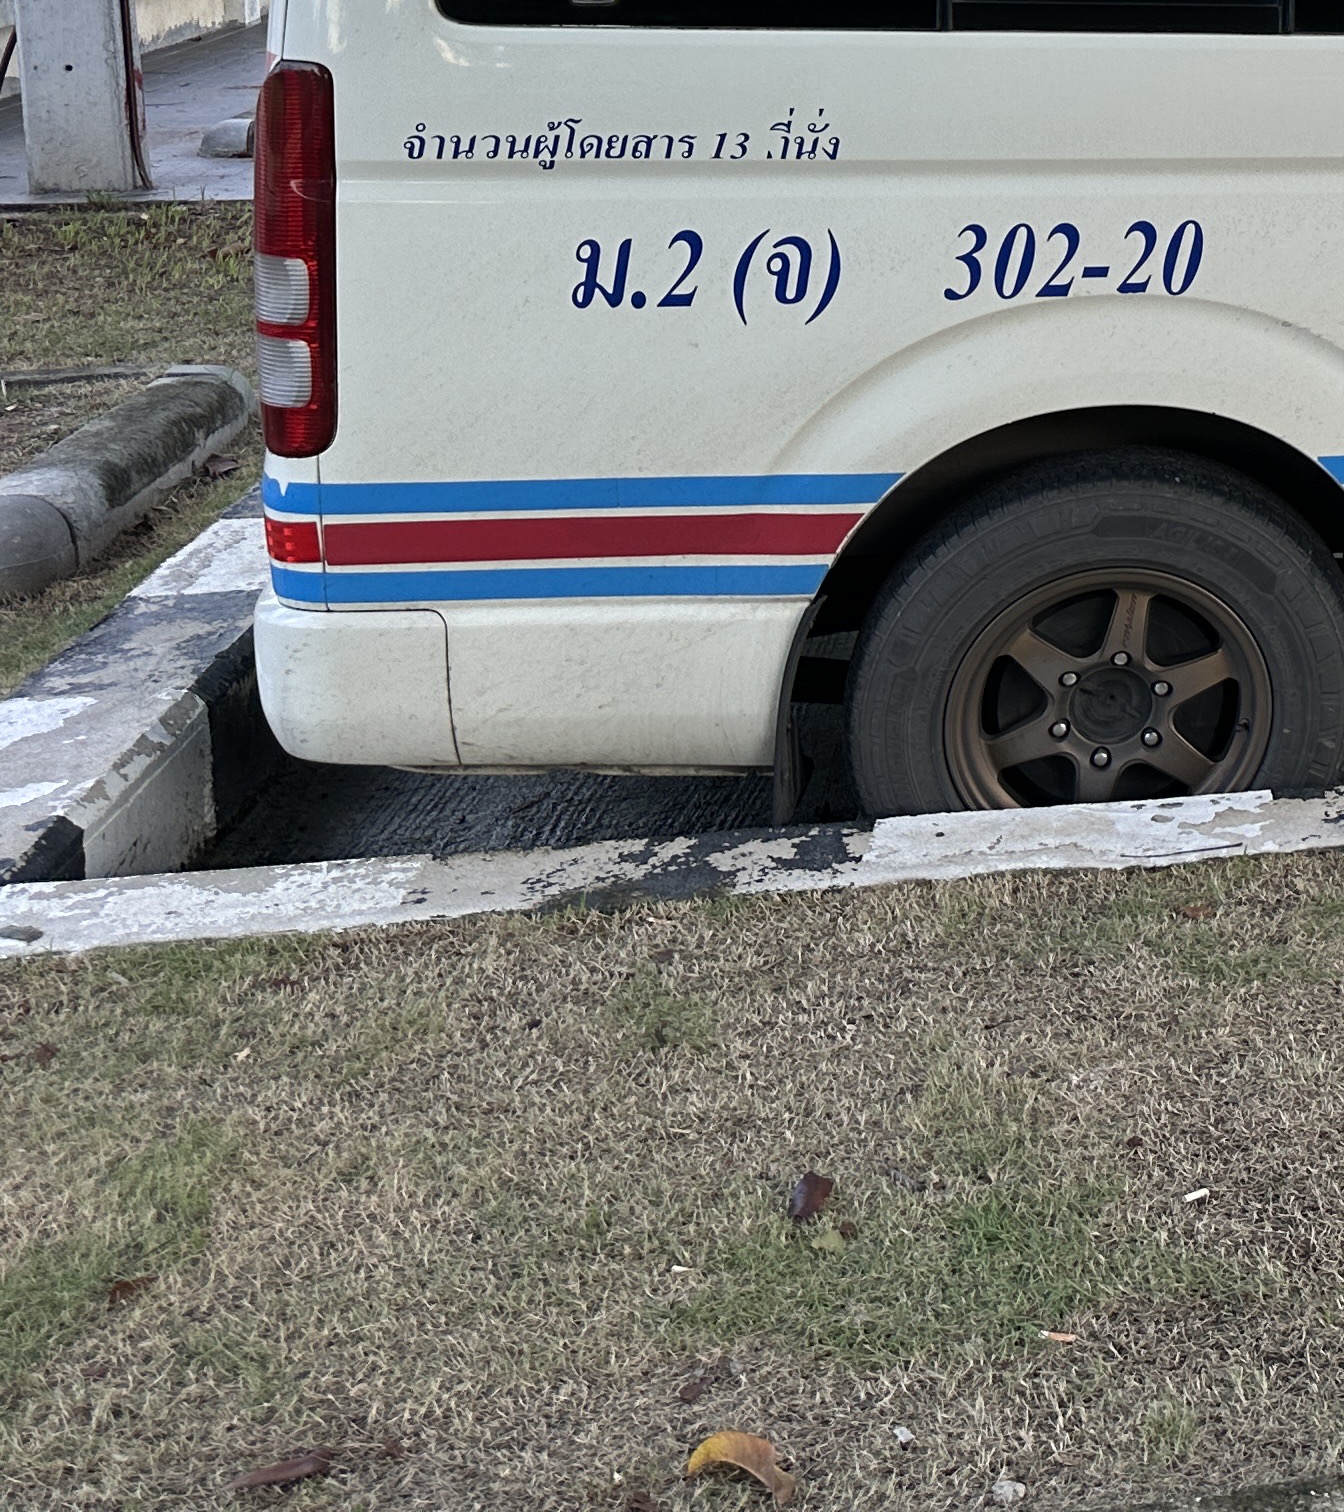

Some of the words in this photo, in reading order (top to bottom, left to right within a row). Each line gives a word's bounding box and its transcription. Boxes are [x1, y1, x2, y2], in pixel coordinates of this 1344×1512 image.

[402, 118, 697, 170] จำนวนผู้โดยสาร
[710, 131, 751, 160] 13
[571, 229, 705, 310] ม.2
[732, 228, 842, 326] (จ)
[943, 219, 1205, 302] 302-20
